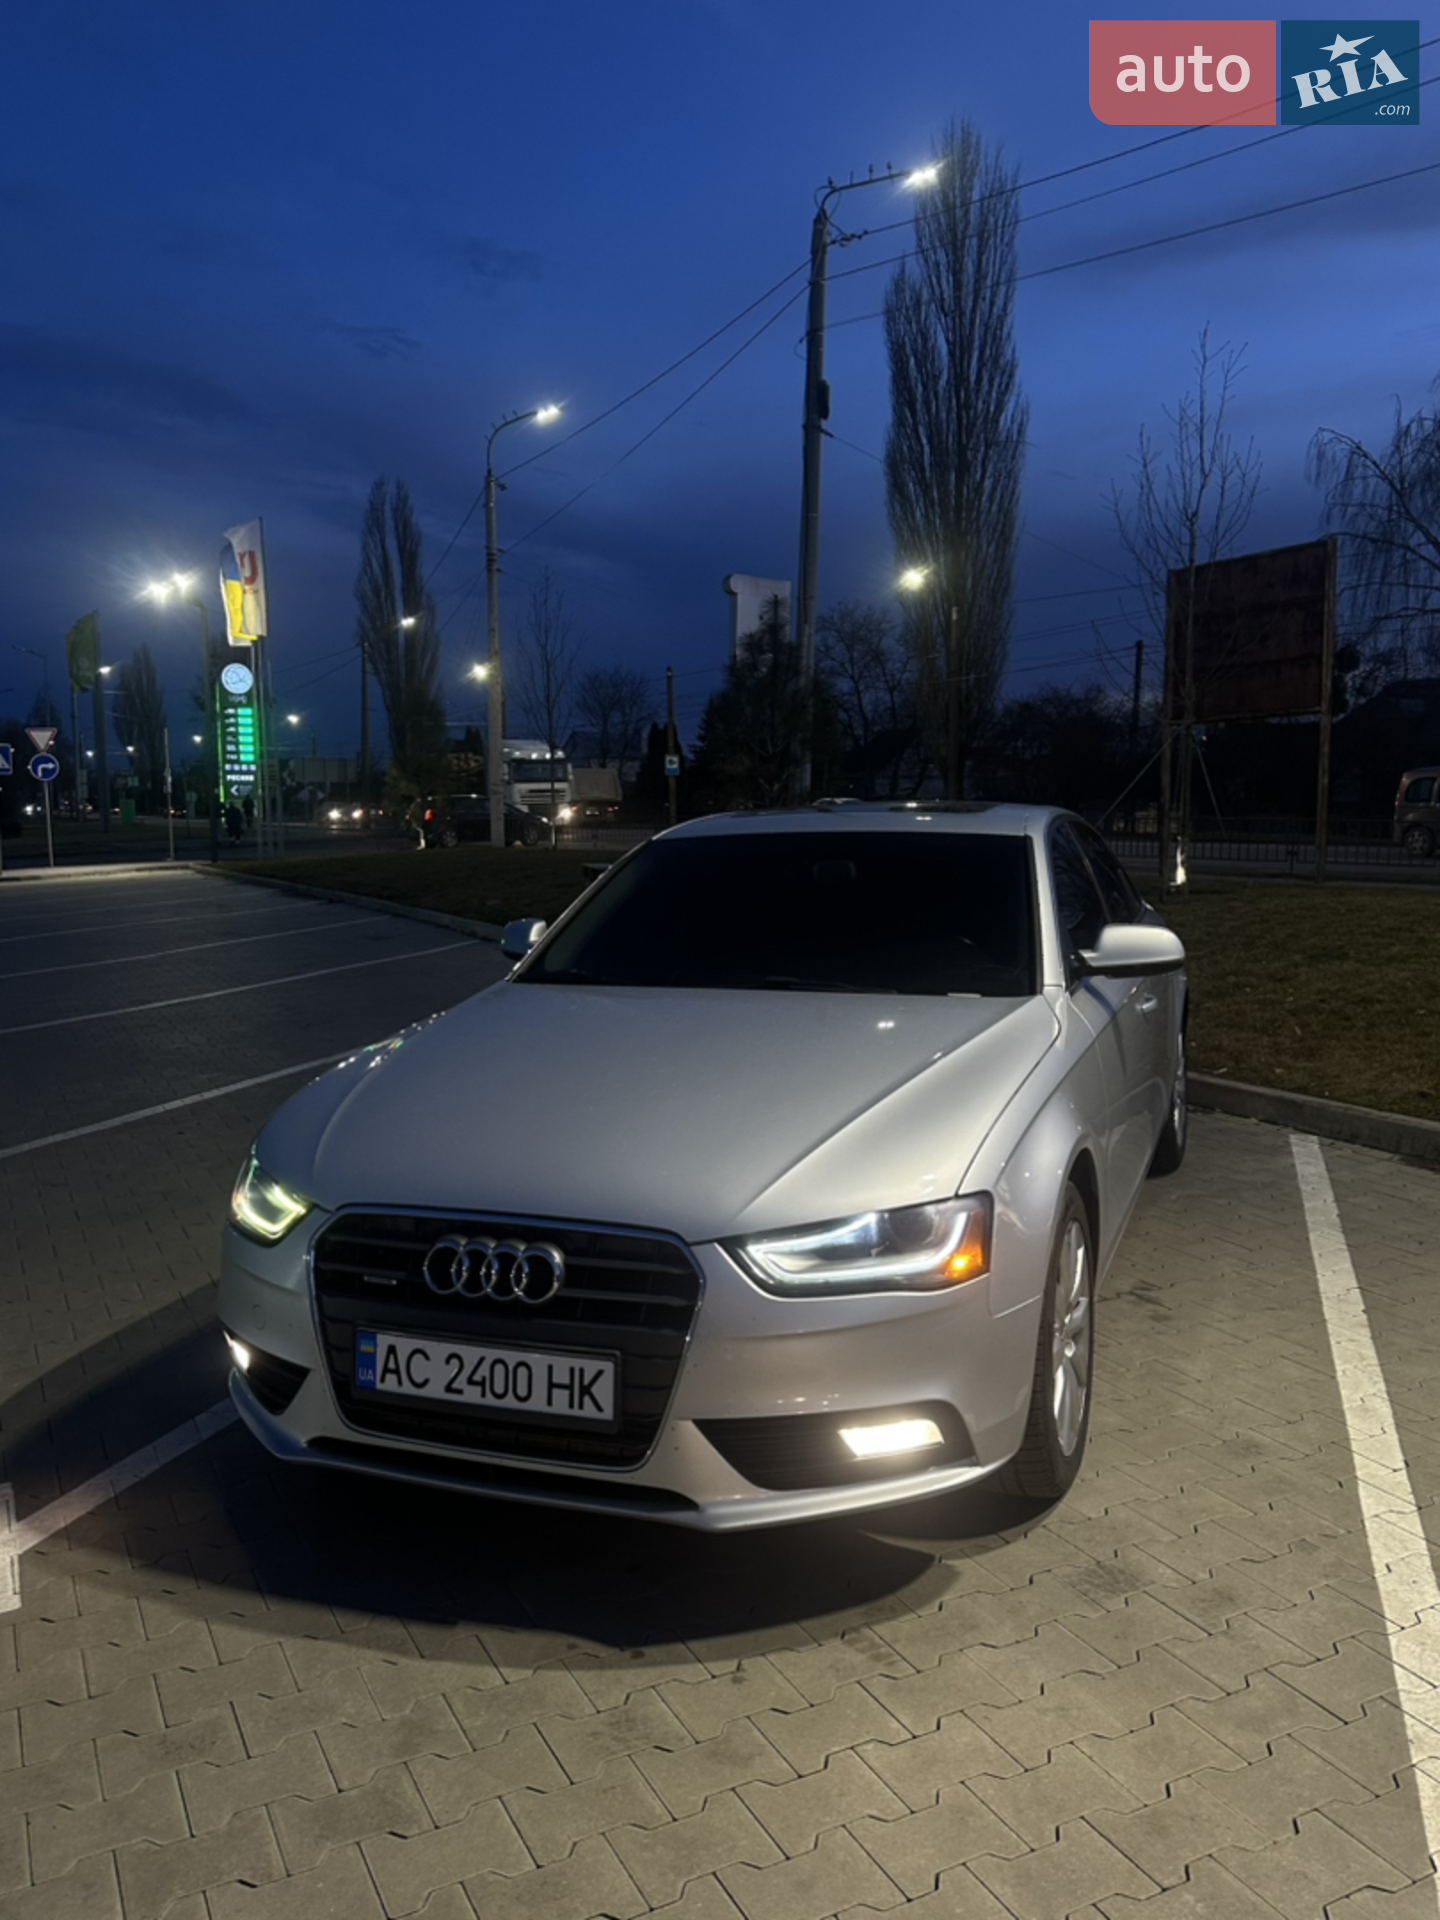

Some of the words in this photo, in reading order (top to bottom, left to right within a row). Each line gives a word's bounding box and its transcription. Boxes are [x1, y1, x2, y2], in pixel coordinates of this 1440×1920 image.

[358, 1367, 375, 1381] UA
[379, 1344, 431, 1389] AC
[444, 1352, 533, 1403] 2400
[547, 1363, 605, 1413] HK
